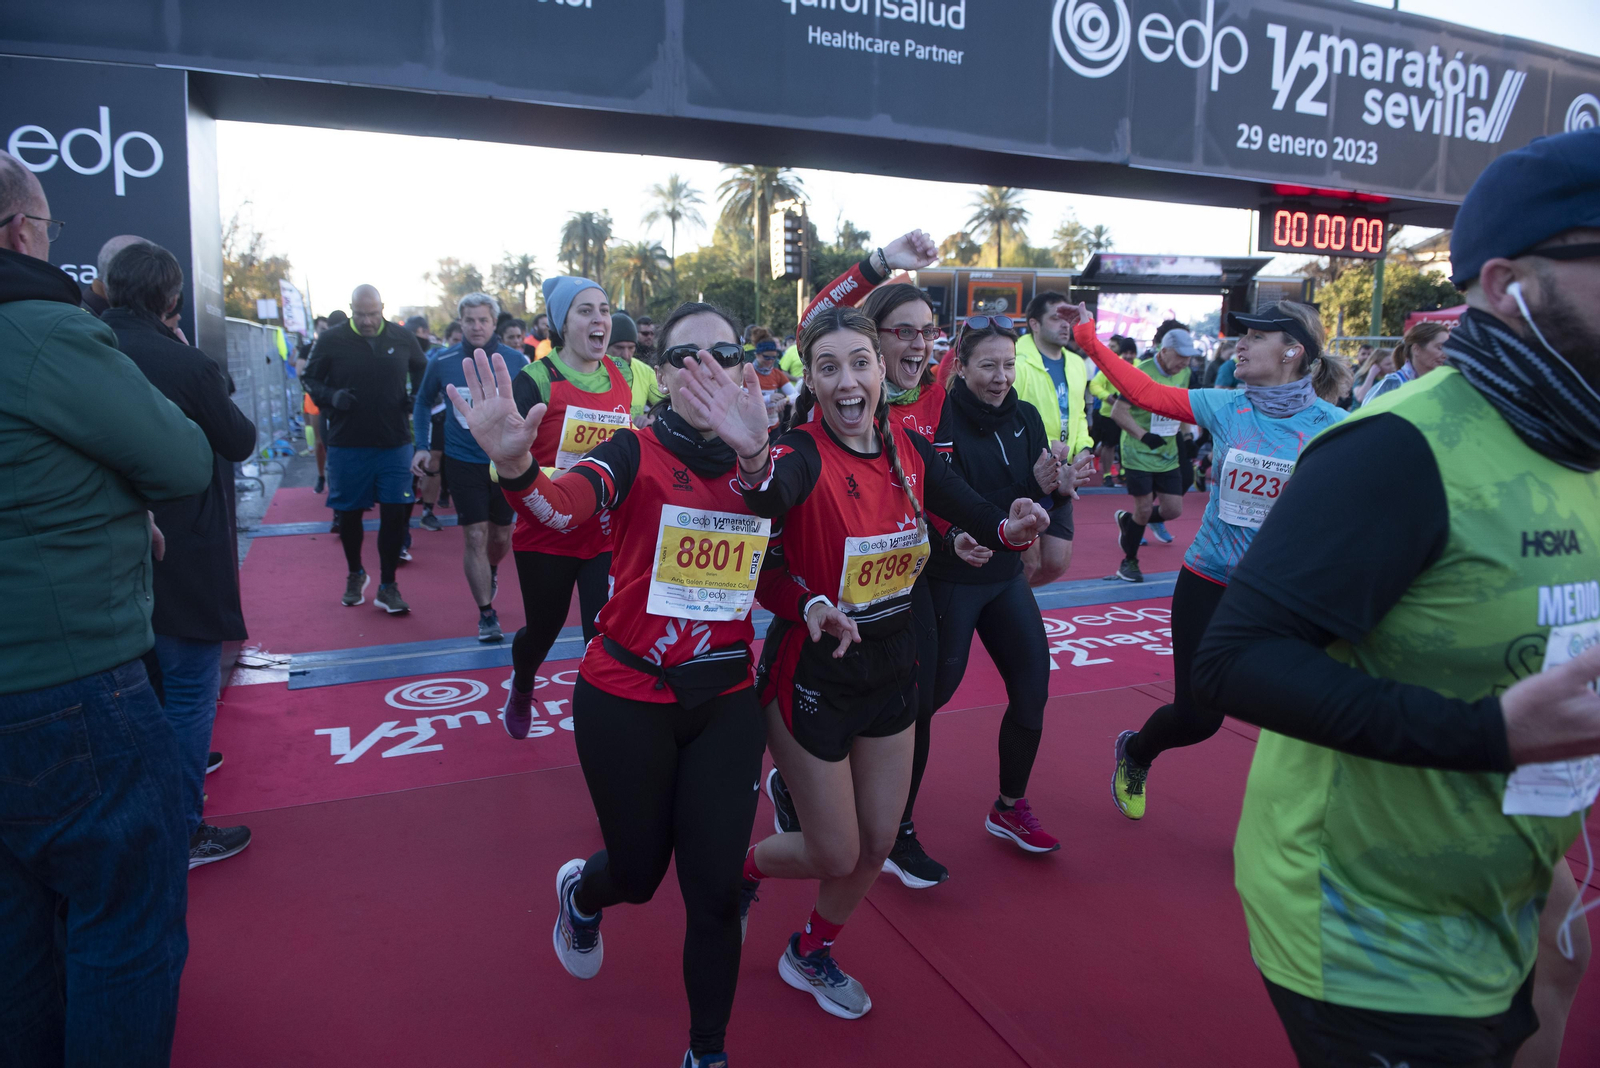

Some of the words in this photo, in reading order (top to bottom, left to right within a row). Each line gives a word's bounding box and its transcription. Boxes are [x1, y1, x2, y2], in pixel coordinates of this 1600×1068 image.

[808, 25, 900, 56] Healthcare
[904, 39, 964, 65] Partner
[1138, 0, 1248, 91] edp
[1319, 33, 1489, 100] maratón
[1361, 87, 1488, 142] sevilla
[7, 106, 164, 196] edp
[1236, 123, 1264, 150] 29
[1268, 135, 1328, 159] enero
[1332, 136, 1378, 165] 2023
[829, 275, 859, 303] RIVAS
[584, 412, 597, 420] edp
[1244, 455, 1260, 466] edp
[692, 515, 710, 528] edp
[723, 517, 756, 527] maratón
[731, 524, 756, 533] sevilla
[676, 536, 745, 572] 8801
[871, 539, 888, 551] edp
[897, 533, 919, 542] marató
[1521, 529, 1582, 557] HOKA
[671, 576, 685, 584] Ana
[858, 553, 912, 587] 8798
[709, 589, 726, 601] edp
[1537, 580, 1600, 627] MEDIO
[1072, 606, 1172, 626] edp
